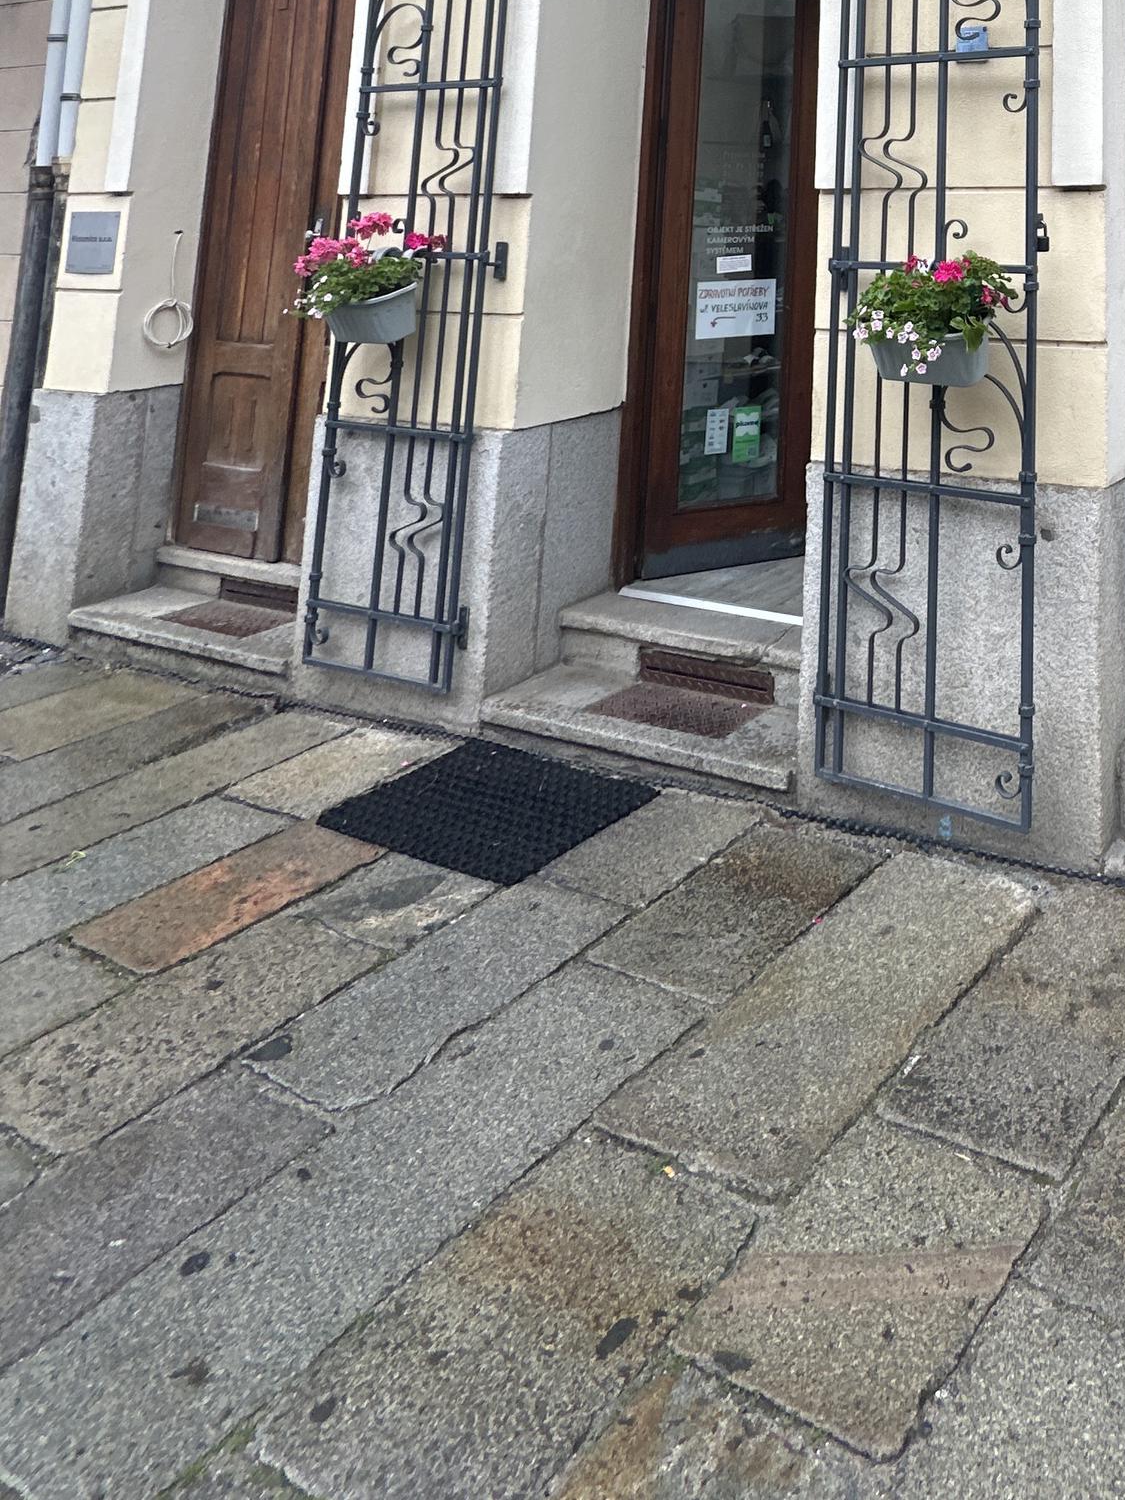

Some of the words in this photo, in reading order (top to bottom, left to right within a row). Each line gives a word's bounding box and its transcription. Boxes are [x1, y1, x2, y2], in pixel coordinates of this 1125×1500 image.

[707, 225, 735, 234] OBJEKT
[736, 225, 744, 234] JE
[706, 234, 755, 244] KAMEROVÝM
[755, 312, 768, 323] 33
